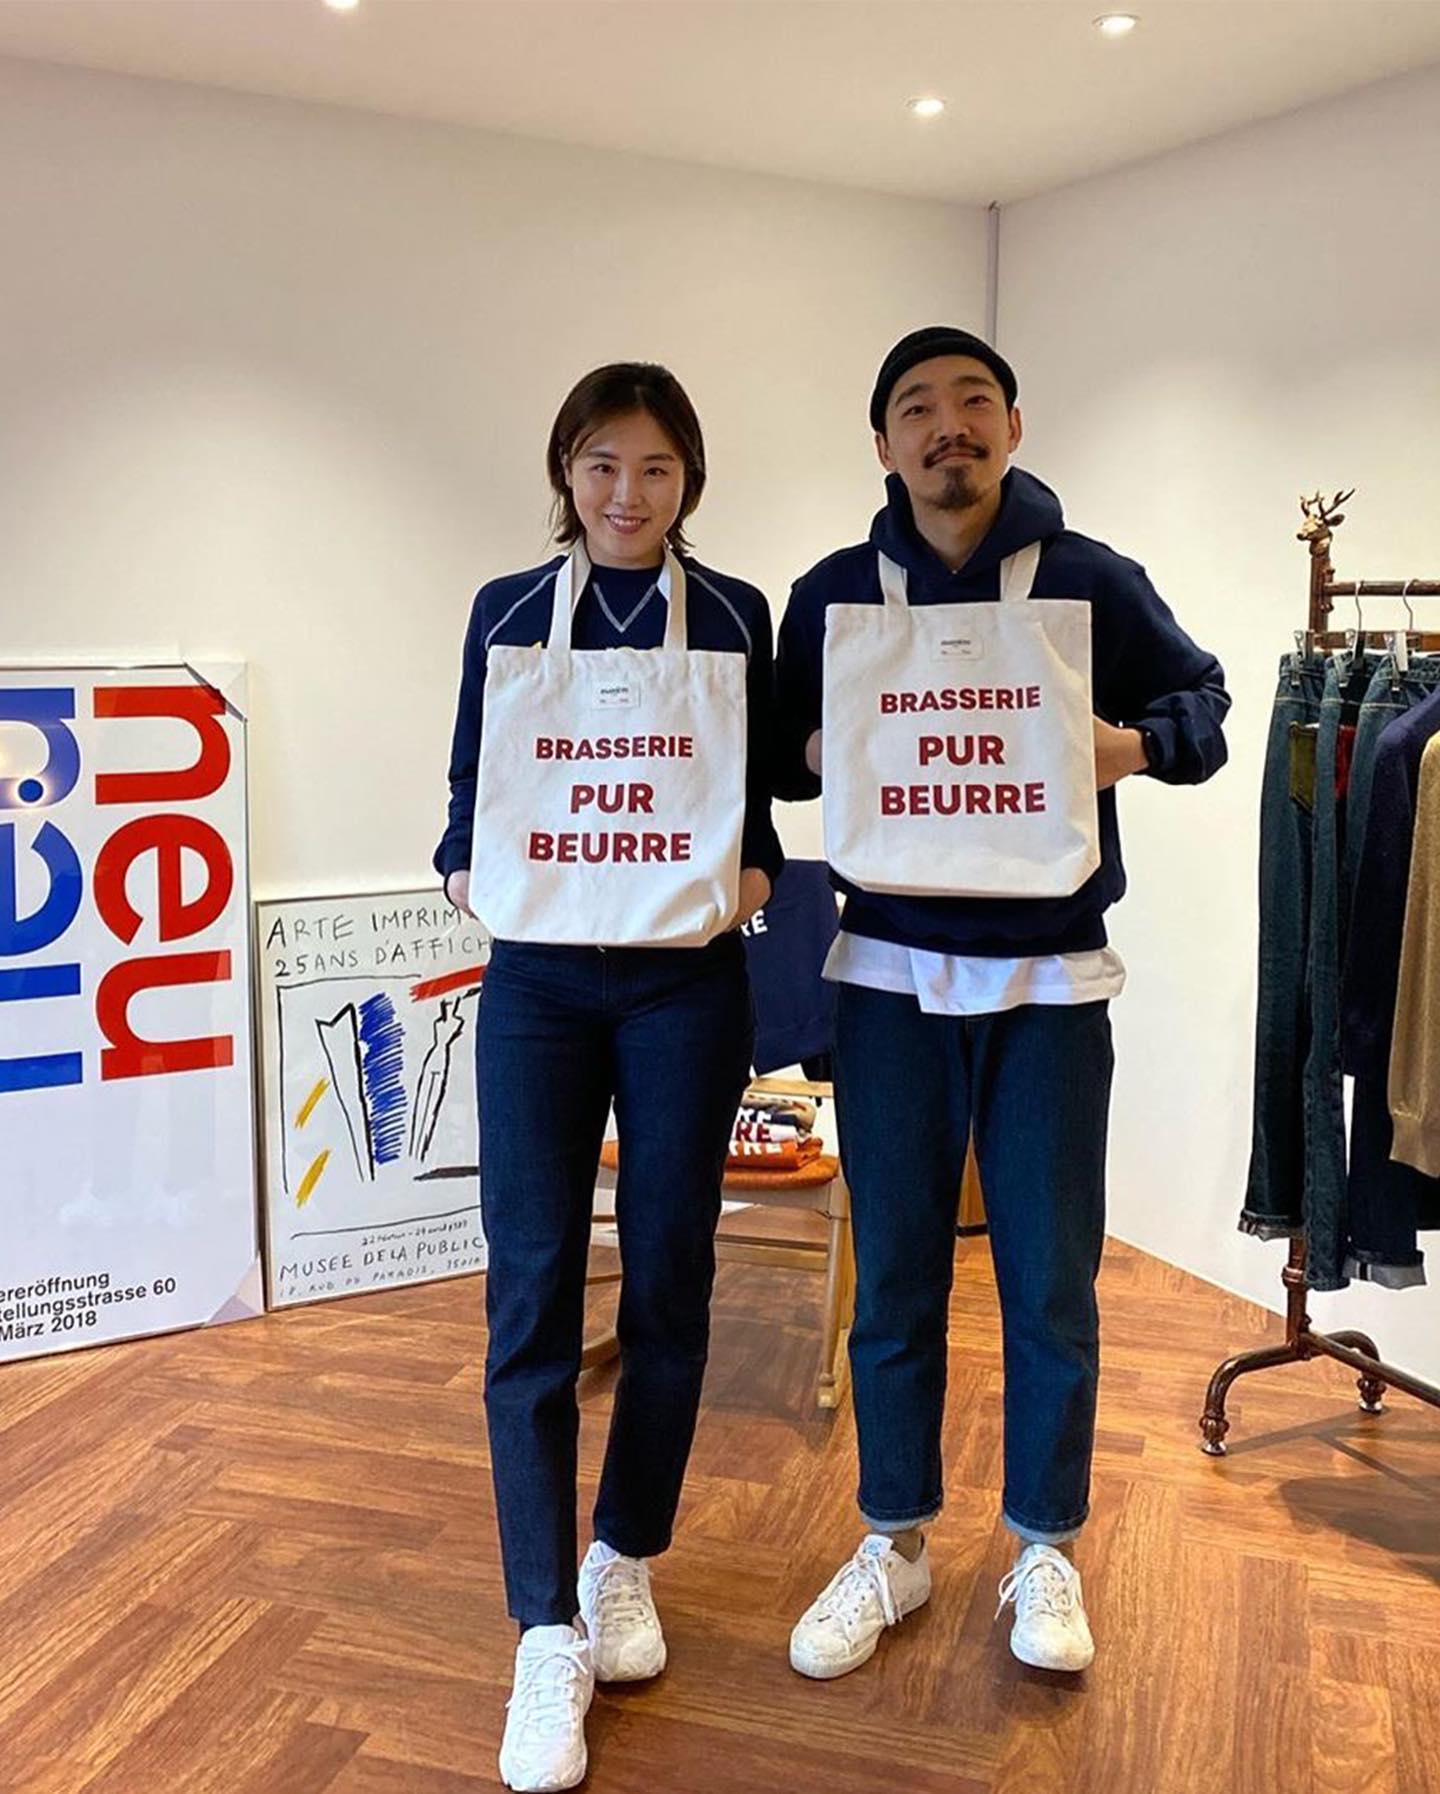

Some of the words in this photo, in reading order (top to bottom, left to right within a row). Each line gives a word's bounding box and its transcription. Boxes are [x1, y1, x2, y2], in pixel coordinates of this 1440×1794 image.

[880, 686, 1041, 713] BRASSERIE
[535, 736, 693, 760] BRASSERIE
[919, 735, 1005, 766] PUR
[570, 783, 654, 814] PUR
[880, 782, 1045, 815] BEURRE
[528, 832, 691, 863] BEURRE
[93, 686, 234, 1081] neu
[266, 914, 354, 950] ARTE
[371, 907, 462, 932] IMPRIM
[279, 1254, 353, 1281] MUSEE
[416, 1236, 484, 1260] PUBLIC
[153, 1277, 176, 1296] 60
[0, 1321, 44, 1342] März
[51, 1310, 97, 1333] 2018
